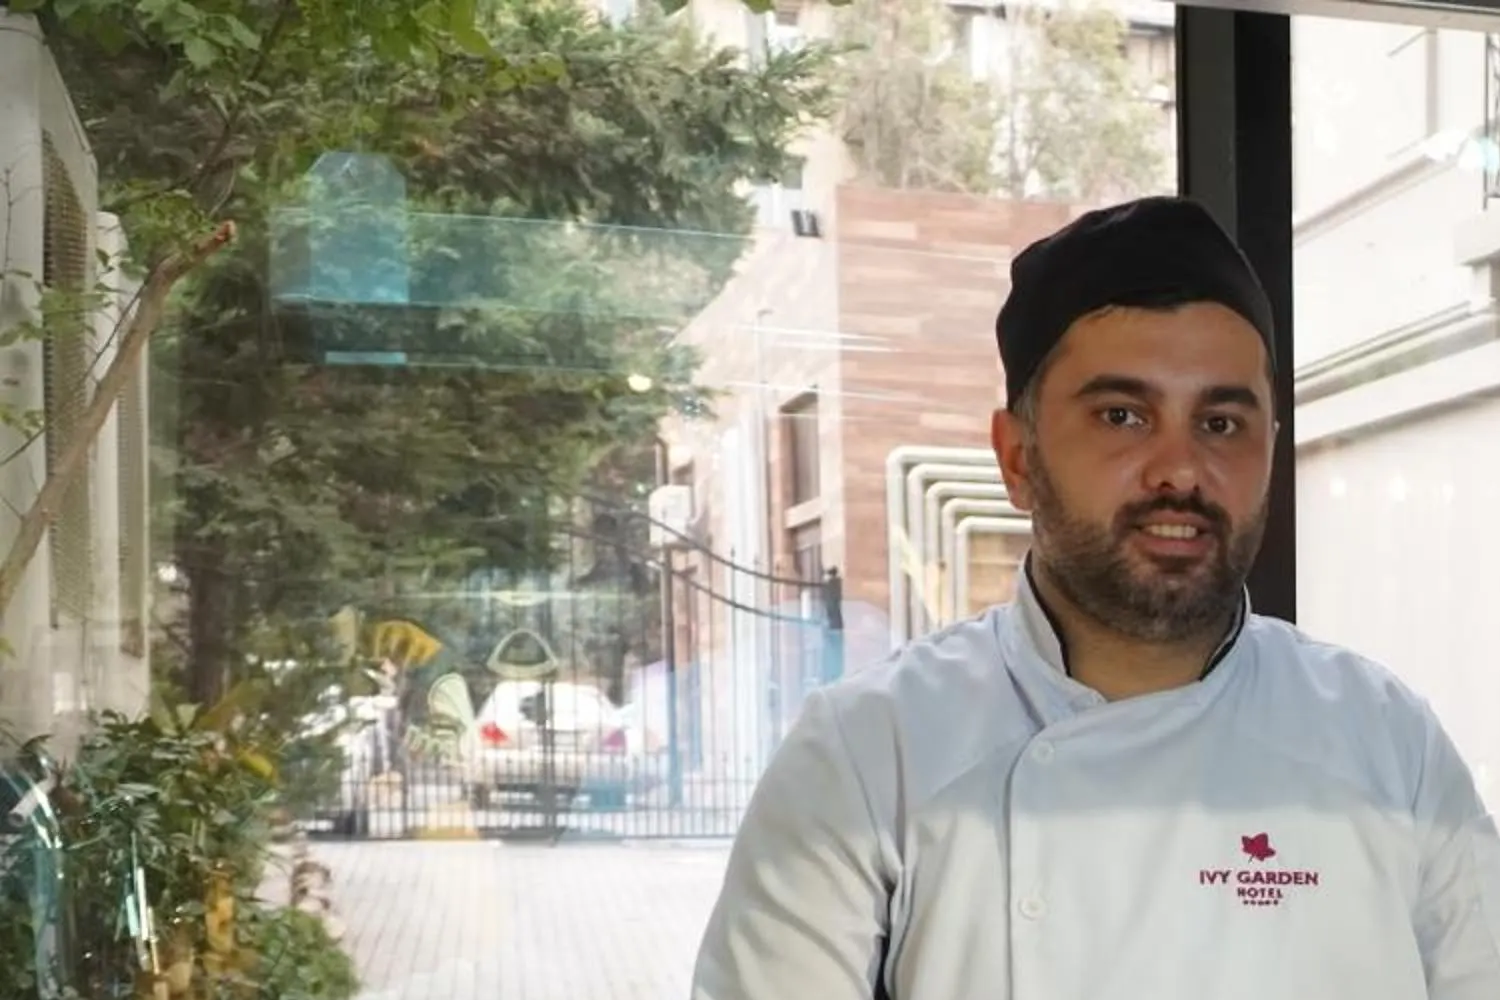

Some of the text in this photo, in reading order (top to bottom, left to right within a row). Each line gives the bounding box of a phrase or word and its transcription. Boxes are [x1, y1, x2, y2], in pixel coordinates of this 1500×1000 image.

[1199, 869, 1319, 886] IVY GARDEN
[1236, 887, 1284, 899] HOTEL
